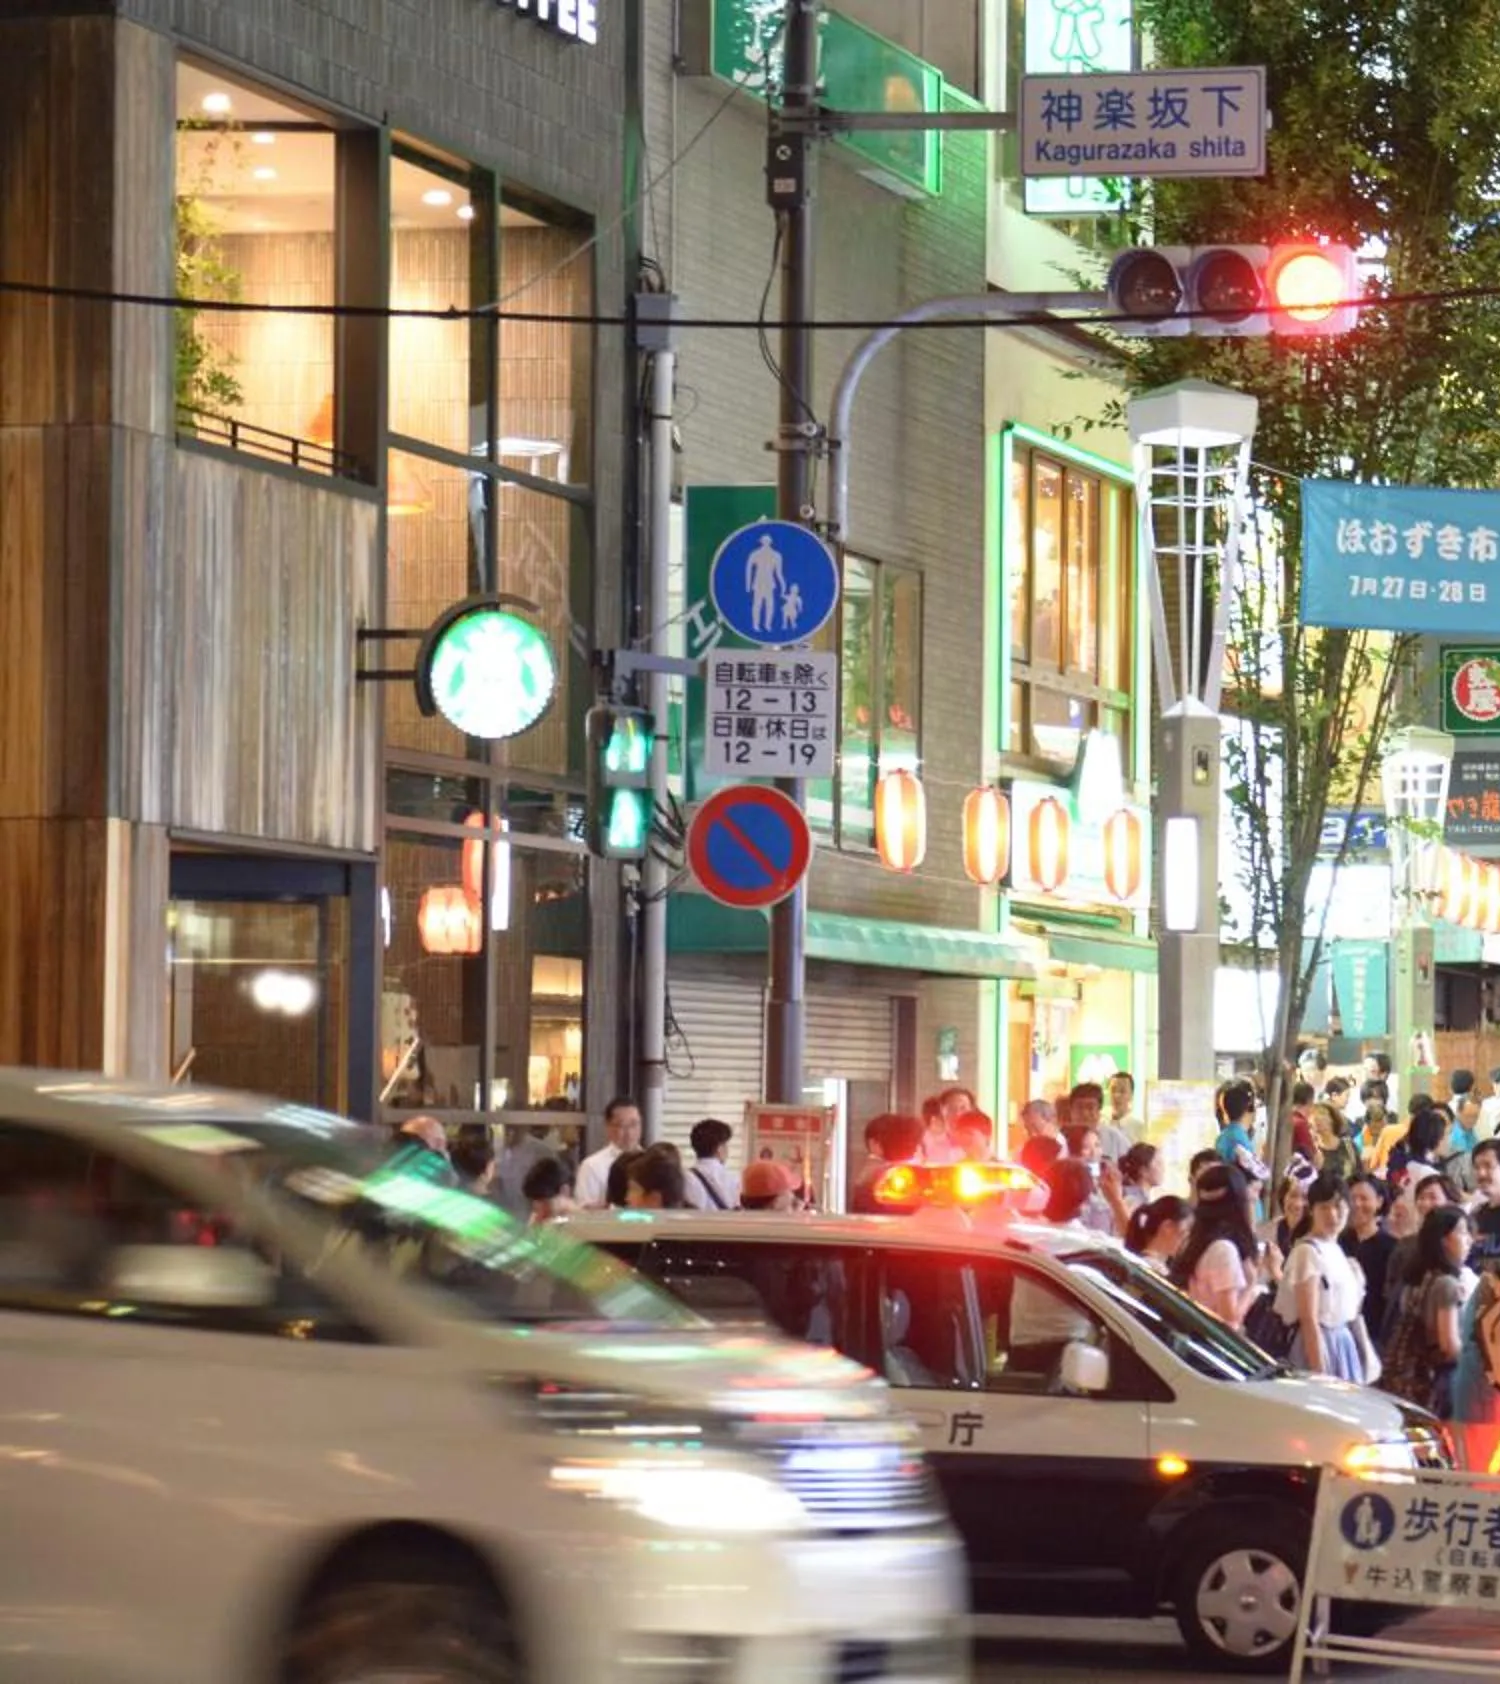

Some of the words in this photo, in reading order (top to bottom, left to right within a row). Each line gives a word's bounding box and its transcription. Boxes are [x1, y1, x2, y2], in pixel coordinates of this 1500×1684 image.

[1040, 86, 1243, 132] 神楽坂下
[1035, 139, 1176, 165] Kagurazaka
[1189, 136, 1246, 158] shita
[1336, 518, 1499, 563] ほおずき市
[715, 661, 829, 686] 自転車を除く
[948, 1410, 984, 1447] 庁
